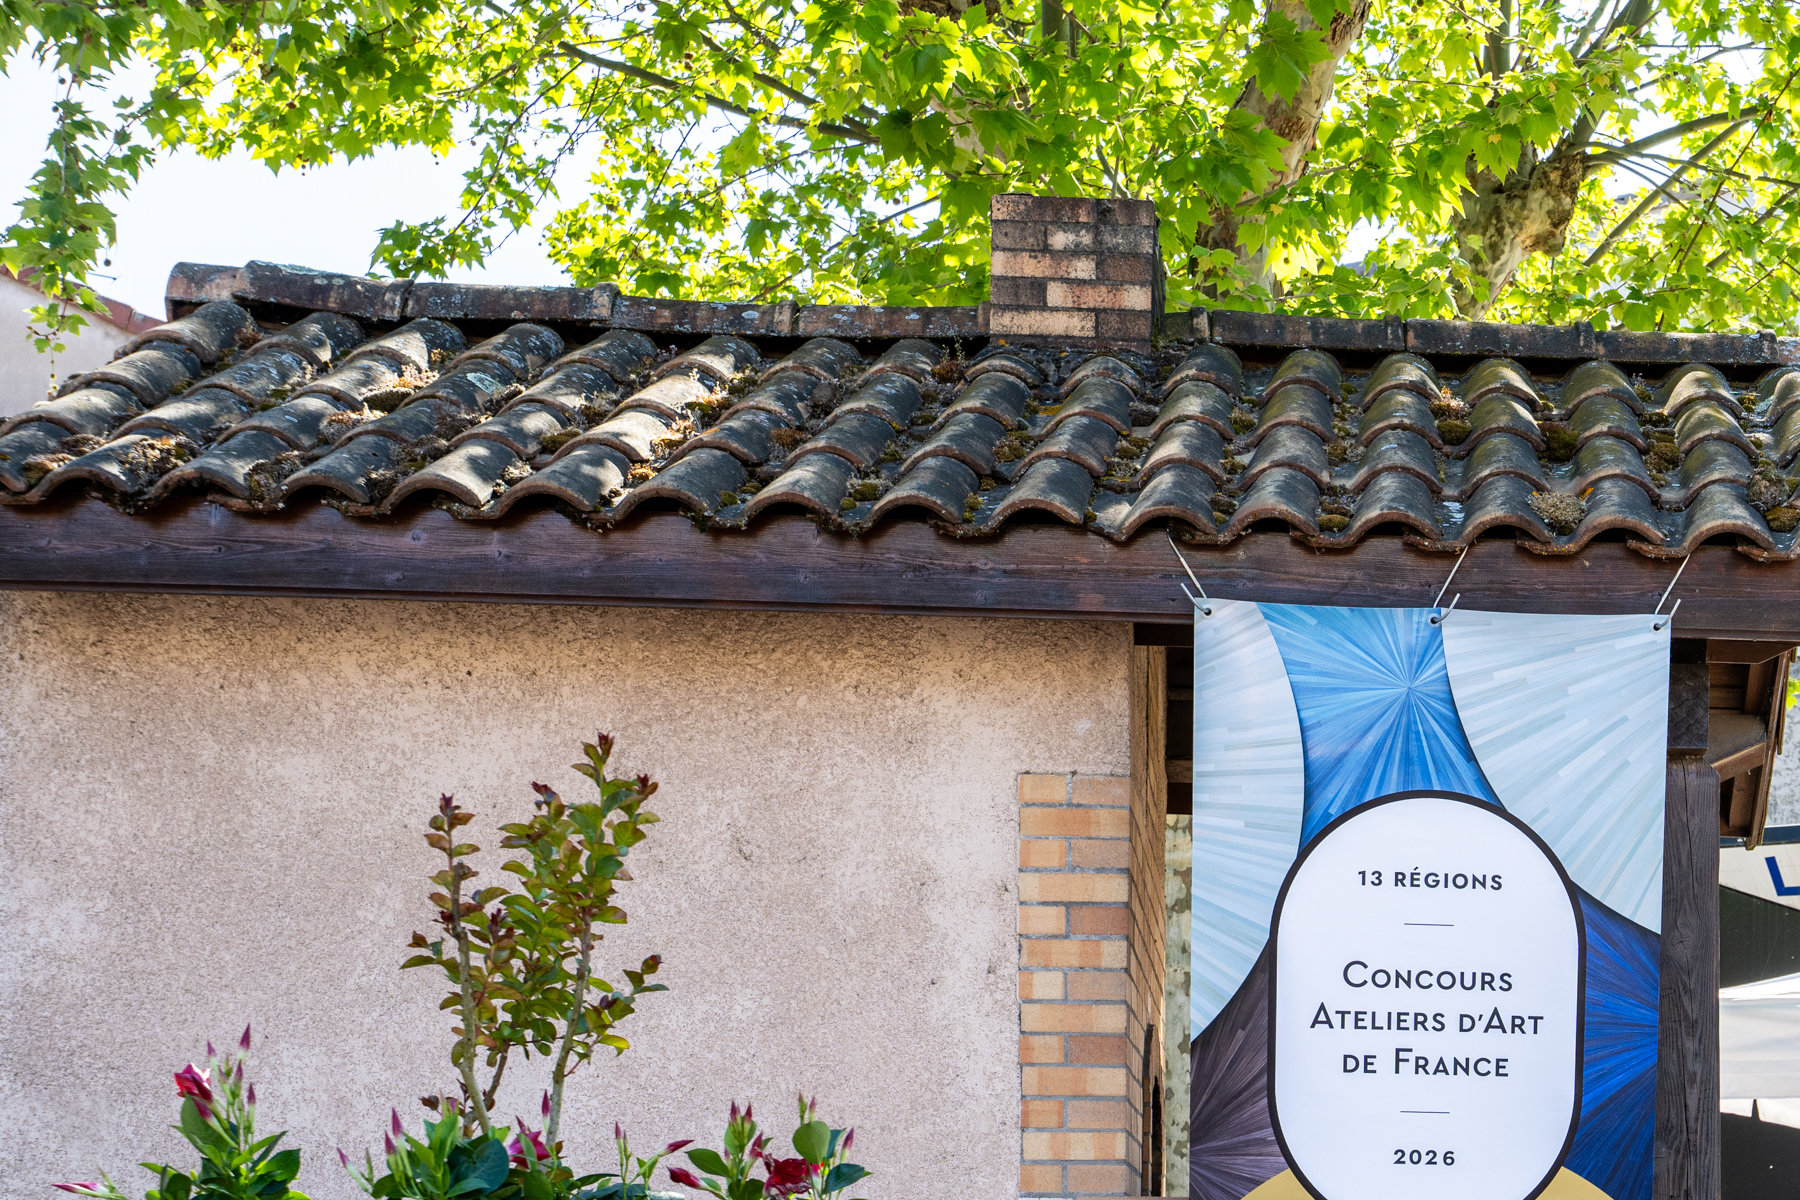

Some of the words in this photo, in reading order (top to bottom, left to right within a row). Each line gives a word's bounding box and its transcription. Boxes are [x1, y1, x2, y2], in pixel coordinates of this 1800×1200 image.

[1357, 870, 1383, 887] 13
[1394, 867, 1503, 891] RÉGIONS
[1342, 959, 1513, 992] CONCOURS
[1310, 1002, 1445, 1033] ATELIERS
[1459, 1007, 1544, 1035] D'ART
[1342, 1053, 1377, 1074] DE
[1394, 1048, 1509, 1077] FRANCE
[1393, 1149, 1456, 1167] 2026
